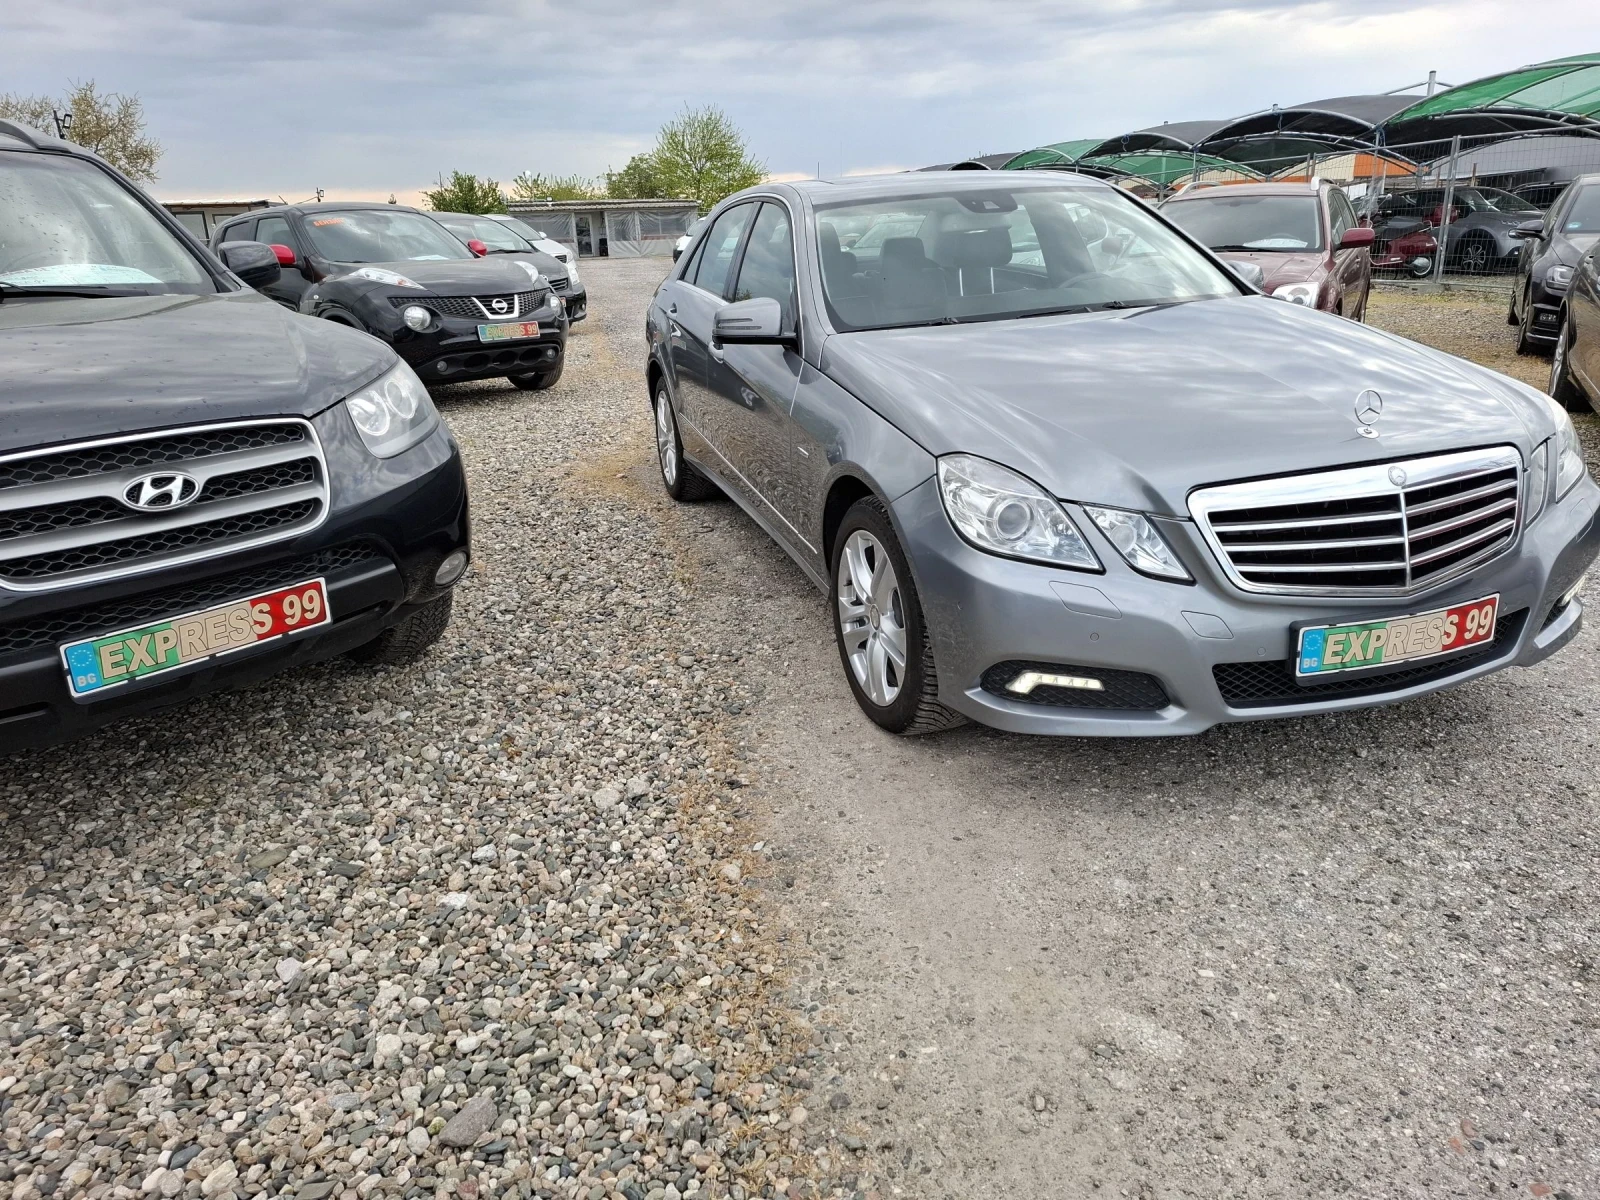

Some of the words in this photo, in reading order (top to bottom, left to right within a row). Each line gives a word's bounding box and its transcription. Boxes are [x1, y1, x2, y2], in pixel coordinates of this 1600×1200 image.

[486, 325, 525, 337] EXPRESS
[527, 324, 537, 334] 99
[100, 602, 272, 679] EXPRESS
[282, 589, 321, 625] 99
[1323, 614, 1458, 665] EXPRESS
[1464, 604, 1493, 640] 99
[1303, 657, 1318, 668] BG
[77, 673, 96, 688] BG
